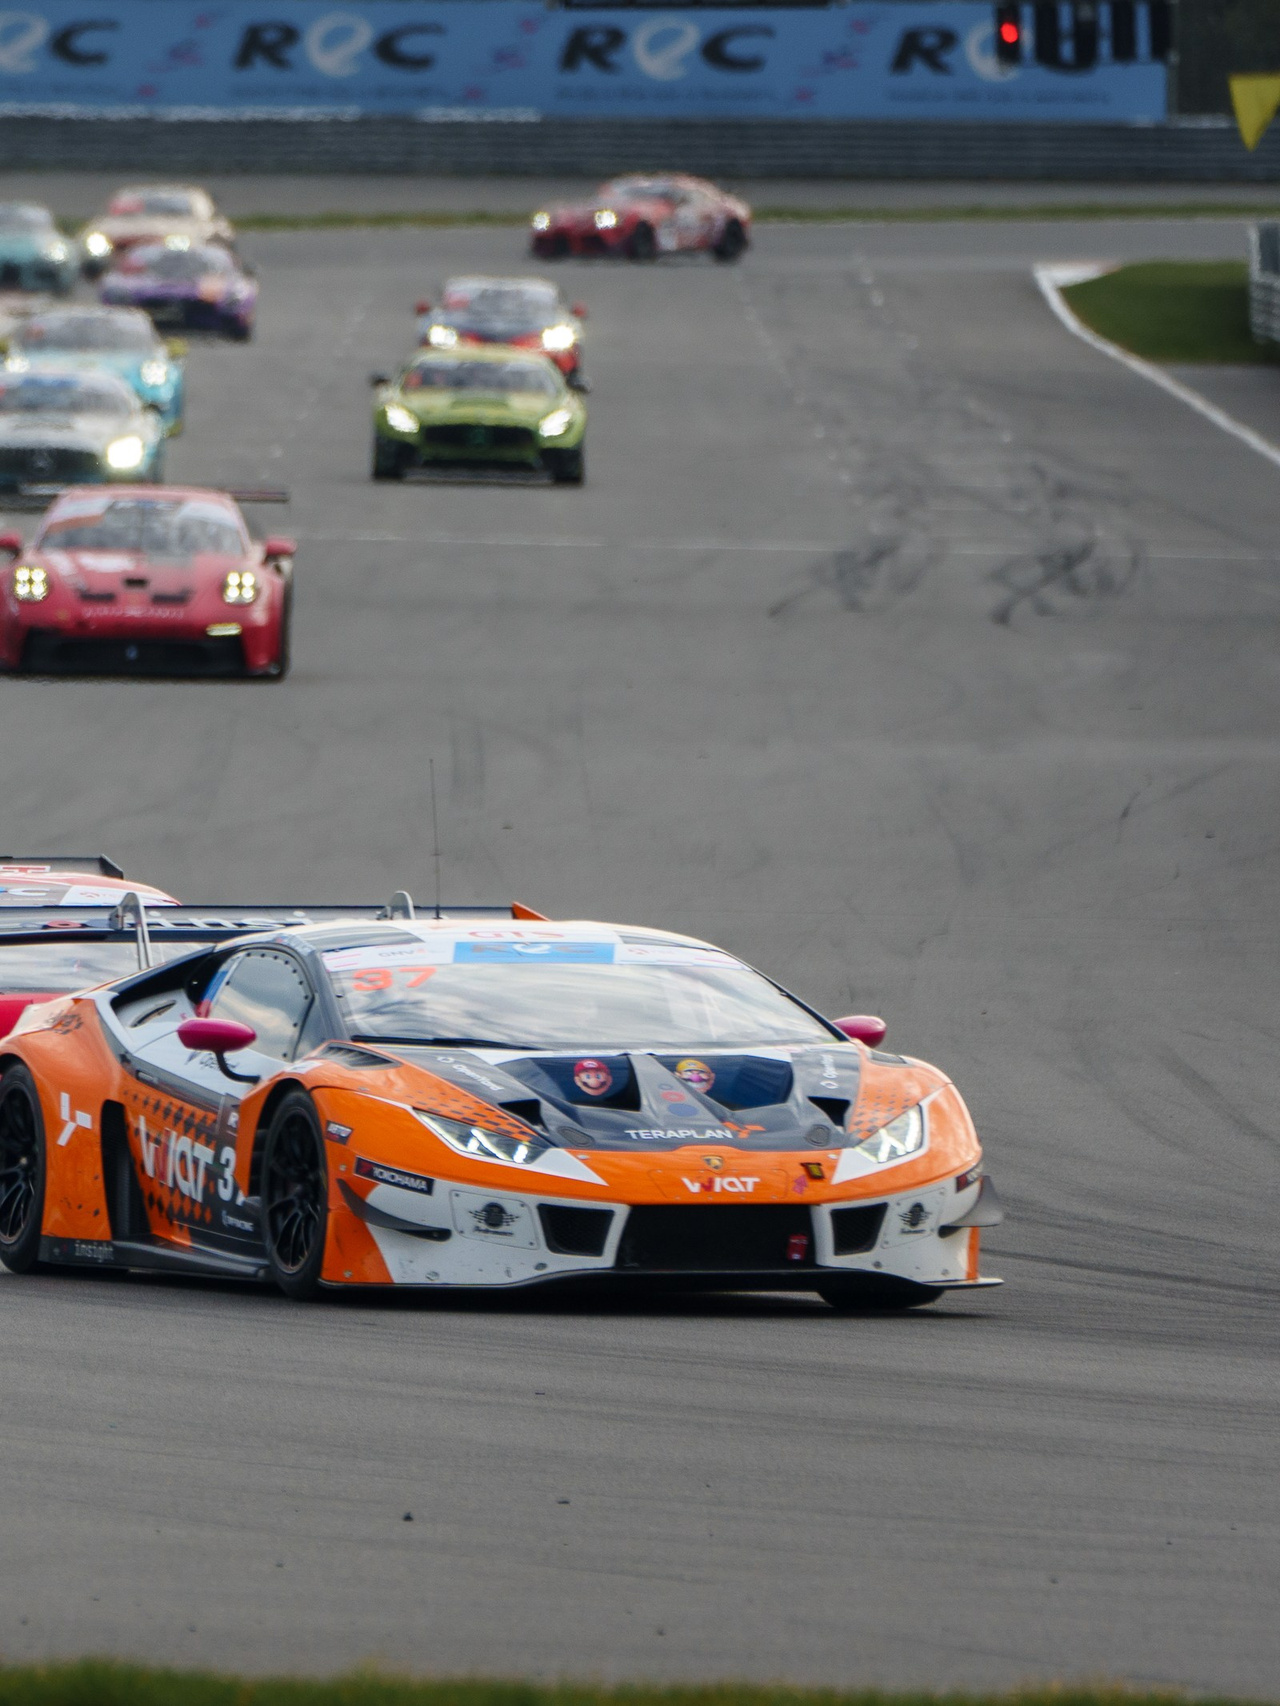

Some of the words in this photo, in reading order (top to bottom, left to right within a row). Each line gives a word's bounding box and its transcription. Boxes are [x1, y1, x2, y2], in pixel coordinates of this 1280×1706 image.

[352, 966, 437, 991] 37
[624, 1129, 734, 1140] TERAPLAN
[372, 1167, 428, 1191] YOKOHAMA
